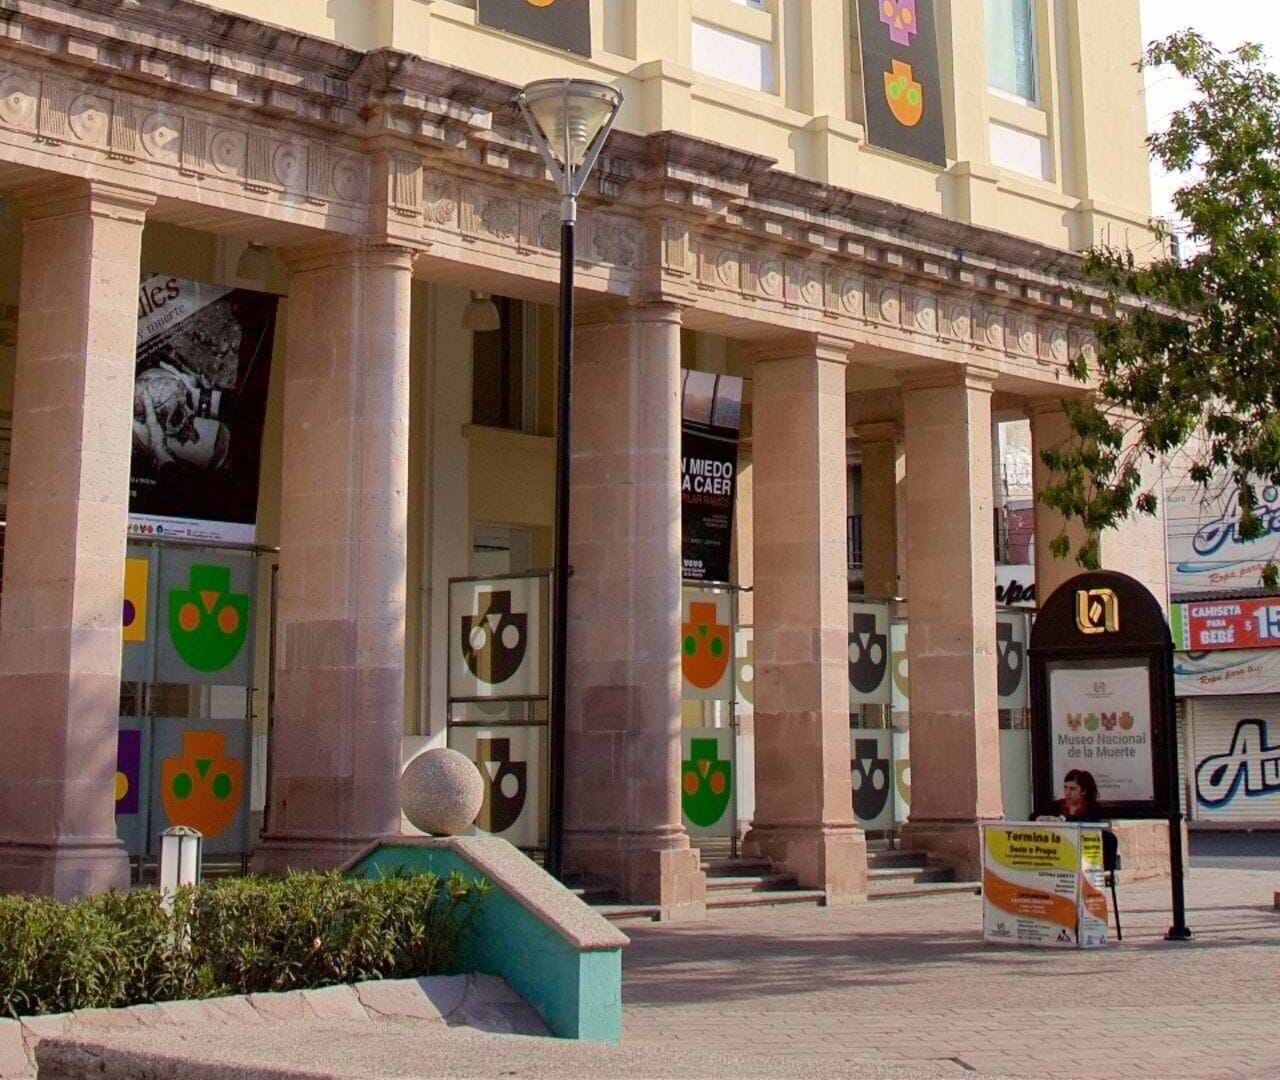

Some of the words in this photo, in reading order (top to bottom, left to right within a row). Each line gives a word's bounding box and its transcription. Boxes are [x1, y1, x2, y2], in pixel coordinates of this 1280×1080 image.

[689, 457, 733, 479] MIEDO
[682, 474, 691, 492] A
[694, 475, 732, 496] CAER
[1190, 604, 1242, 618] CAMISETA
[1206, 619, 1227, 628] PARA
[1200, 624, 1235, 645] BEBÉ
[1058, 733, 1094, 745] Museo
[1097, 732, 1147, 745] Nacional
[1067, 746, 1081, 758] de
[1083, 746, 1093, 758] la
[1096, 746, 1137, 758] Muerte
[1006, 830, 1049, 843] Termina
[1051, 832, 1061, 844] la
[1009, 844, 1027, 854] Secu
[1035, 845, 1057, 856] Prepa
